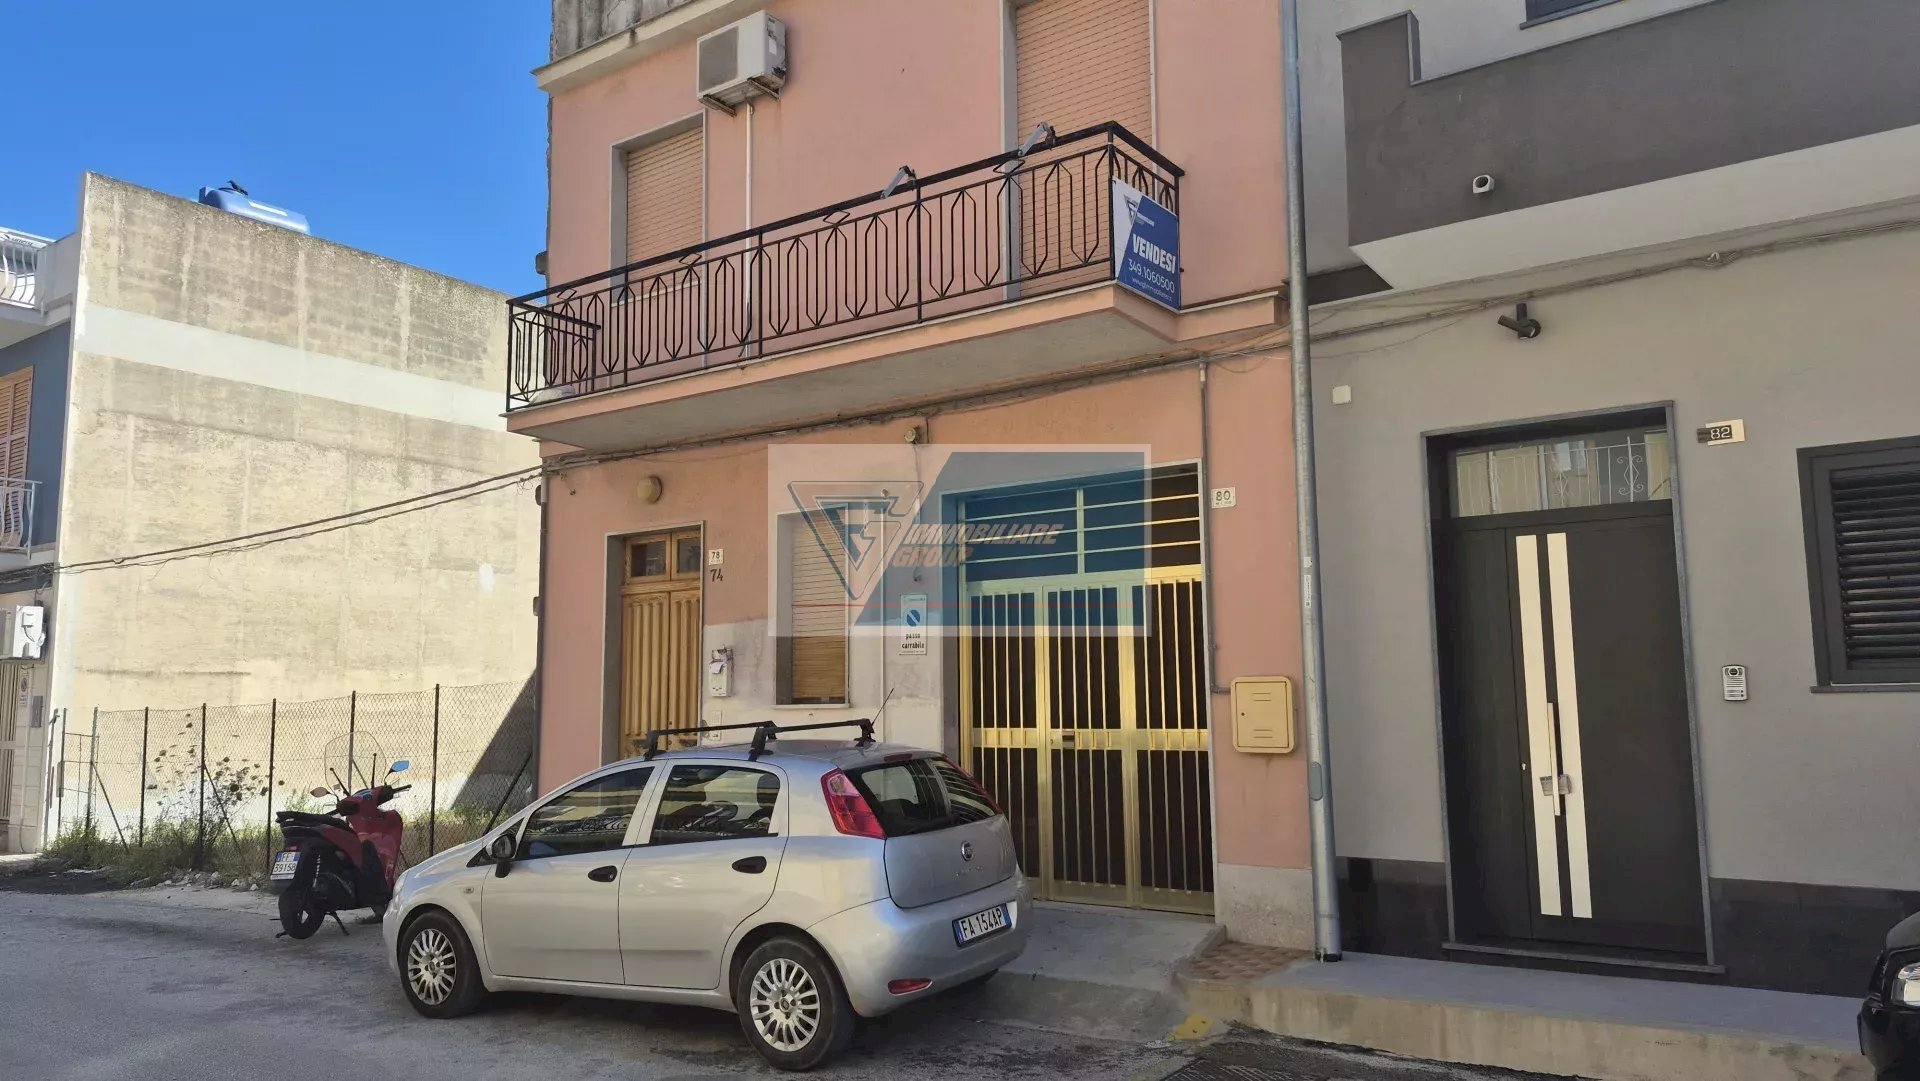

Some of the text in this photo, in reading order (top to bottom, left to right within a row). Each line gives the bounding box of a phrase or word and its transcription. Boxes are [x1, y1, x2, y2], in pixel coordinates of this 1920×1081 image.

[1133, 233, 1176, 274] VENDESI
[1128, 258, 1175, 294] 349.1060500
[1710, 426, 1730, 440] 82
[1215, 490, 1231, 502] 80
[711, 551, 721, 560] 78
[710, 568, 724, 582] 74
[905, 633, 921, 641] passo
[901, 641, 925, 649] carrabile
[961, 908, 1002, 938] FA 154AP
